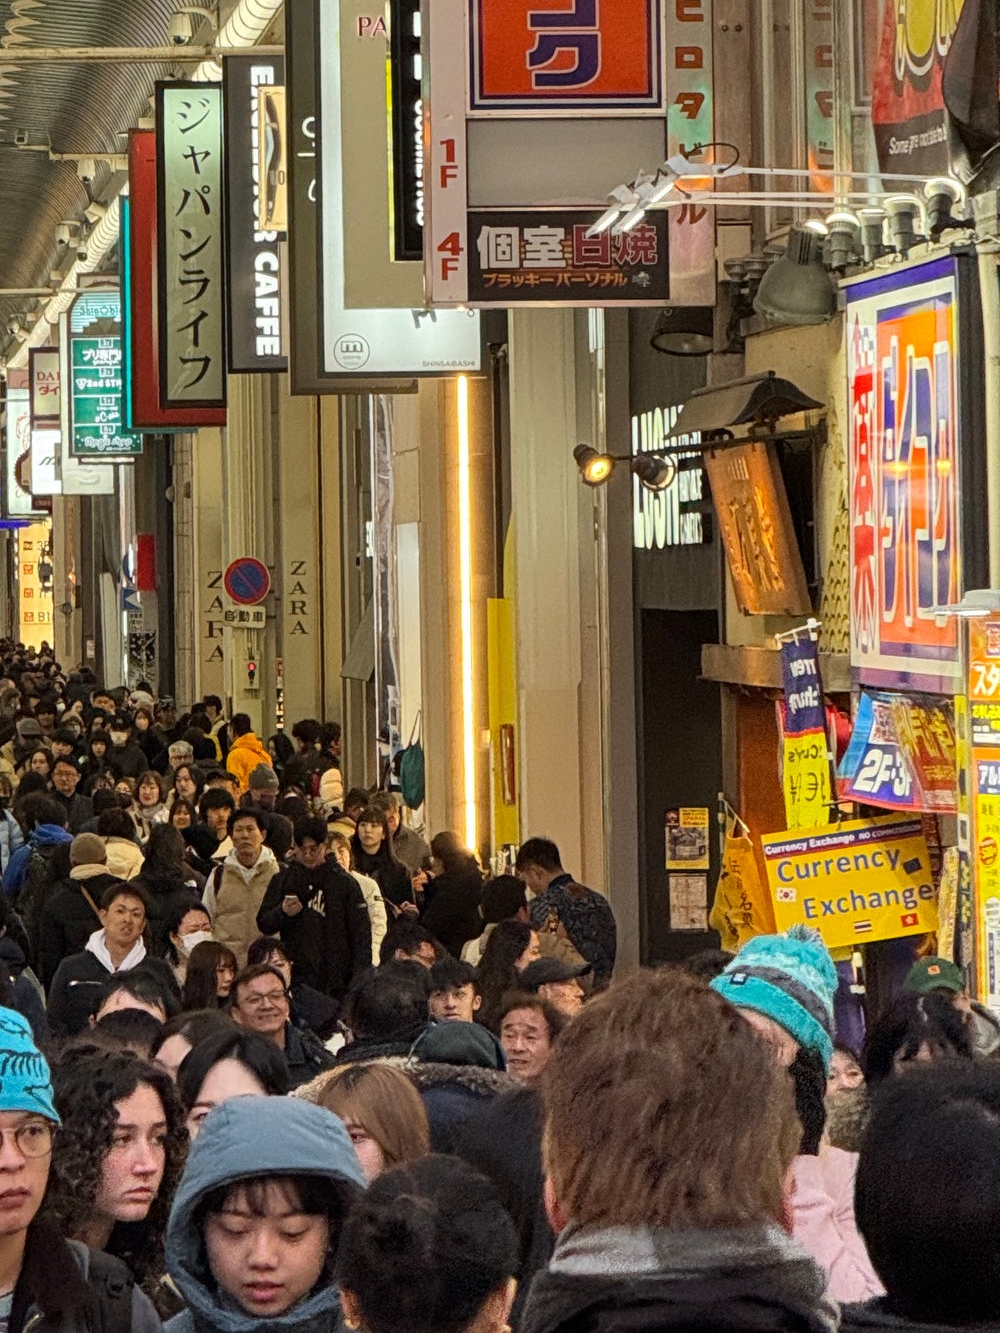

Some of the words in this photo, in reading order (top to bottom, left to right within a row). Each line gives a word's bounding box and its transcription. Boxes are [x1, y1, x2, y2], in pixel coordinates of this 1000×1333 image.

[174, 97, 213, 390] ジャパンライフ
[254, 251, 281, 357] CAFFE
[224, 609, 265, 623] 自動車
[288, 560, 309, 635] ZARA
[764, 840, 808, 856] Currency
[809, 833, 855, 848] Exchange
[858, 830, 871, 841] NO
[777, 848, 901, 883] Currency
[803, 883, 934, 920] Exchange
